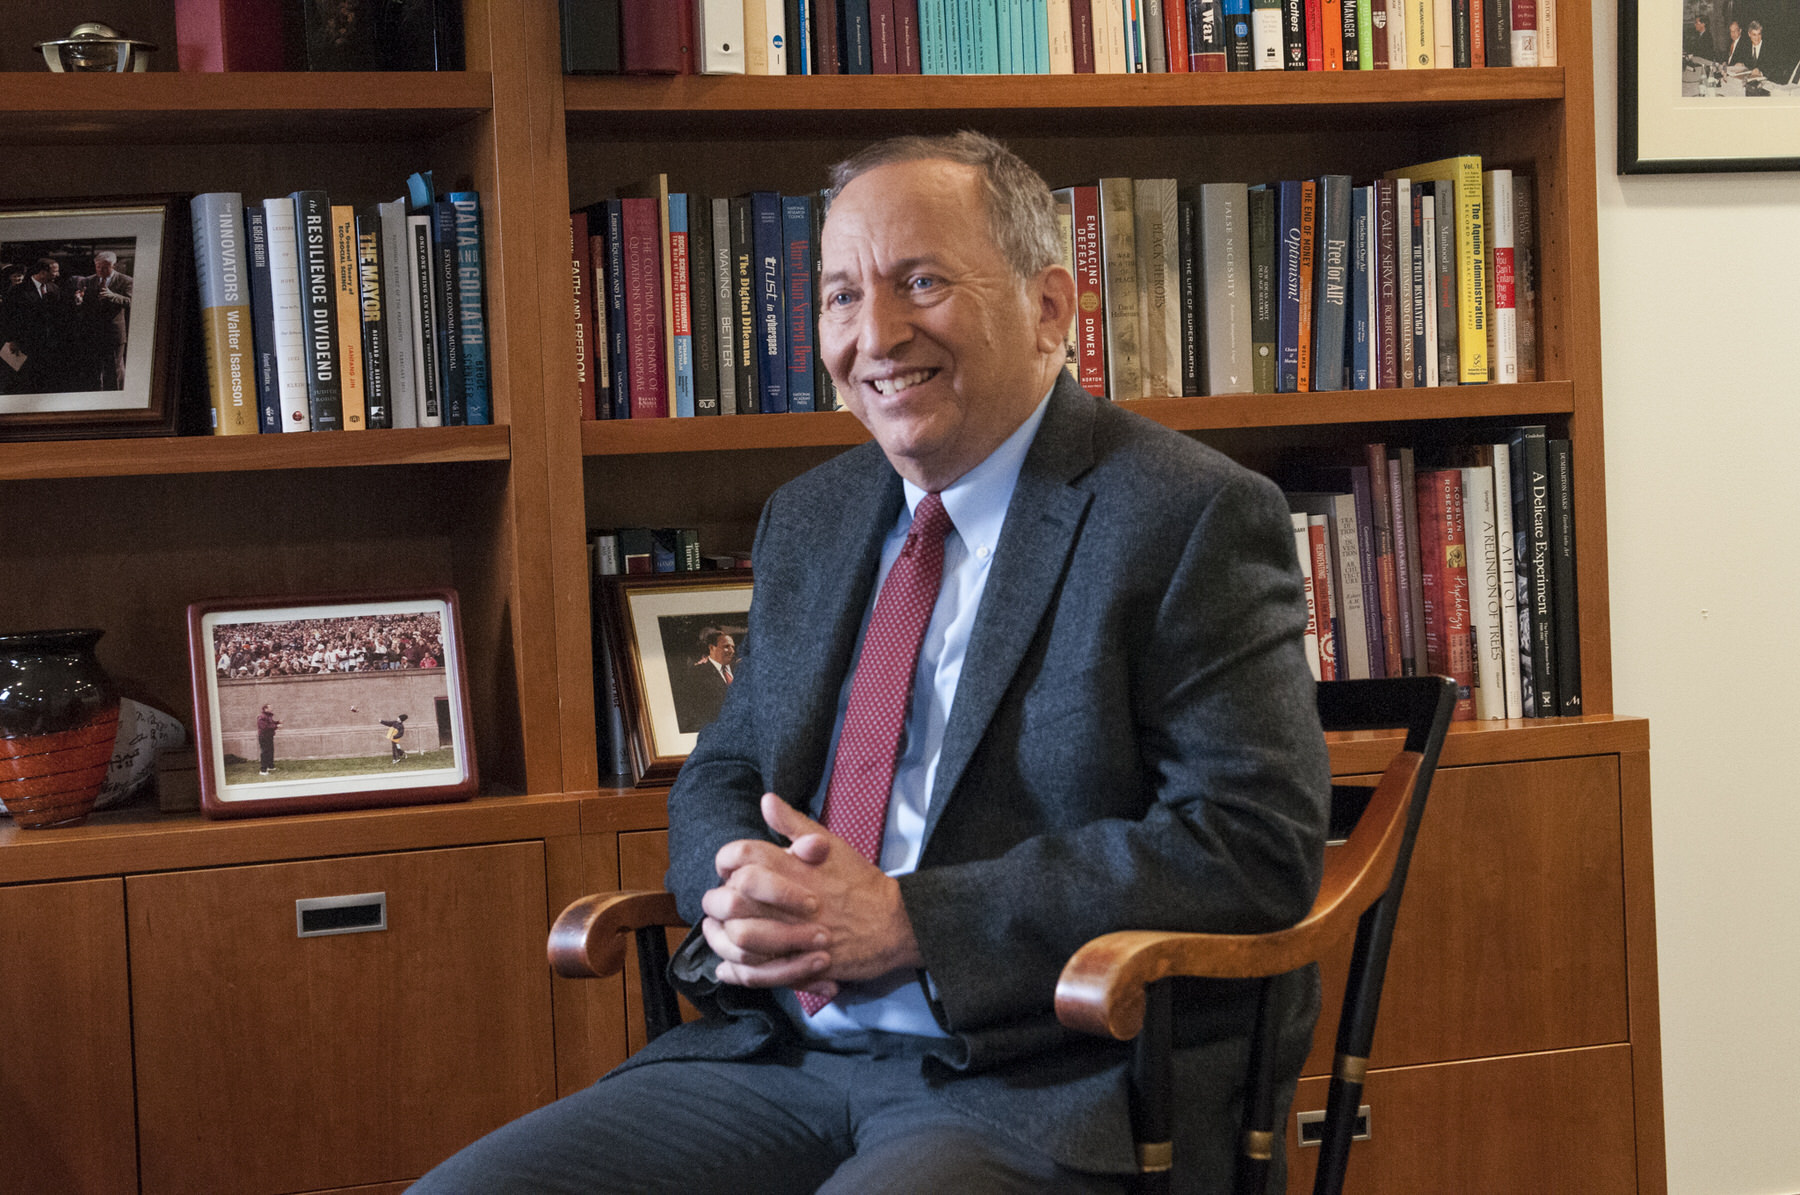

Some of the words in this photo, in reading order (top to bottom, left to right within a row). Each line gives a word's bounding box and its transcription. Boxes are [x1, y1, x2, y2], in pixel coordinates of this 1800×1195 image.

[1202, 8, 1215, 43] War
[309, 200, 318, 213] the
[1304, 188, 1313, 203] THE
[1381, 184, 1392, 208] THE
[1472, 203, 1481, 220] The
[252, 215, 262, 225] THE
[454, 201, 478, 247] DATA
[1225, 201, 1233, 233] FALSE
[1303, 225, 1312, 236] OF
[1304, 206, 1313, 223] END
[1381, 209, 1393, 239] CALL
[253, 226, 264, 243] GREAT
[339, 226, 347, 264] ECO-SOCIAL
[360, 233, 377, 265] THE
[643, 236, 653, 254] THE
[1077, 228, 1088, 273] DEFEAT
[1087, 215, 1098, 286] EMBRACING
[1152, 223, 1164, 259] BLACK
[1303, 238, 1311, 267] MONEY
[1328, 240, 1346, 264] Free
[1413, 245, 1422, 259] THE
[1441, 226, 1449, 263] Manhood
[1471, 223, 1482, 256] Aquino
[219, 214, 239, 302] INNOVATORS
[255, 244, 265, 268] REBIRTH
[307, 216, 327, 304] RESILIENCE
[444, 249, 454, 280] ESTADO
[612, 243, 620, 277] EQUALITY,
[629, 236, 642, 300] QUOTATIONS
[697, 236, 706, 285] MAHLER
[720, 248, 730, 299] MAKING
[740, 254, 750, 276] The
[791, 241, 808, 270] More
[1227, 238, 1236, 298] NECESSITY
[1284, 228, 1301, 303] Optimism!
[1327, 265, 1344, 282] for
[1414, 260, 1422, 282] TRULY
[1442, 264, 1449, 272] at
[361, 265, 381, 322] MAYOR
[446, 281, 455, 292] DA
[571, 261, 581, 295] FAITH
[643, 258, 657, 310] COLUMBIA
[765, 257, 777, 301] trust
[792, 271, 809, 300] Than
[1154, 263, 1166, 309] HEROES
[1382, 253, 1393, 298] SERVICE
[1403, 262, 1411, 297] CHANGES
[459, 267, 483, 345] GOLIATH
[614, 294, 622, 310] LAW
[680, 292, 689, 333] GOVERNMENT
[699, 287, 707, 312] AND
[739, 278, 751, 315] Digital
[767, 304, 775, 312] in
[1187, 298, 1193, 311] OF
[1326, 283, 1344, 307] All?
[1403, 298, 1412, 313] AND
[1414, 284, 1424, 336] DISADVANTAGED
[1473, 259, 1484, 330] Administration
[227, 311, 240, 349] Walter
[447, 292, 458, 334] ECONOMIA
[633, 303, 642, 331] FROM
[792, 303, 810, 342] Screen
[1385, 304, 1393, 336] ROBERT
[313, 310, 332, 381] DIVIDEND
[372, 330, 380, 357] RICHARD
[426, 332, 431, 340] US
[449, 335, 458, 372] MUNDIAL
[575, 323, 586, 382] FREEDOM
[646, 314, 658, 375] DICTIONARY
[702, 334, 710, 371] WORLD
[722, 317, 733, 368] BETTER
[742, 317, 752, 367] Dilemma
[766, 315, 778, 356] cyberspace
[1086, 318, 1096, 358] DOWER
[1385, 337, 1394, 366] COLES
[1404, 314, 1413, 362] CHALLENGES
[634, 335, 646, 391] SHAKESPEARE
[788, 346, 811, 373] Deep
[230, 354, 243, 407] Isaacson
[650, 378, 659, 392] OF
[1533, 471, 1545, 483] A
[1444, 479, 1454, 542] ROSENBERG
[1454, 486, 1463, 532] KOSSLYN
[1483, 521, 1494, 532] A
[1534, 487, 1547, 538] Delicate
[1396, 523, 1406, 548] LIVING
[1316, 543, 1327, 579] REINVENTING
[1399, 551, 1408, 590] PORTRAIT
[1485, 535, 1498, 598] REUNION
[1501, 530, 1515, 609] CAPITOL
[1533, 542, 1550, 616] Experiment
[1448, 576, 1468, 630] Psychology
[1488, 601, 1499, 619] OF
[1491, 625, 1503, 661] TREES
